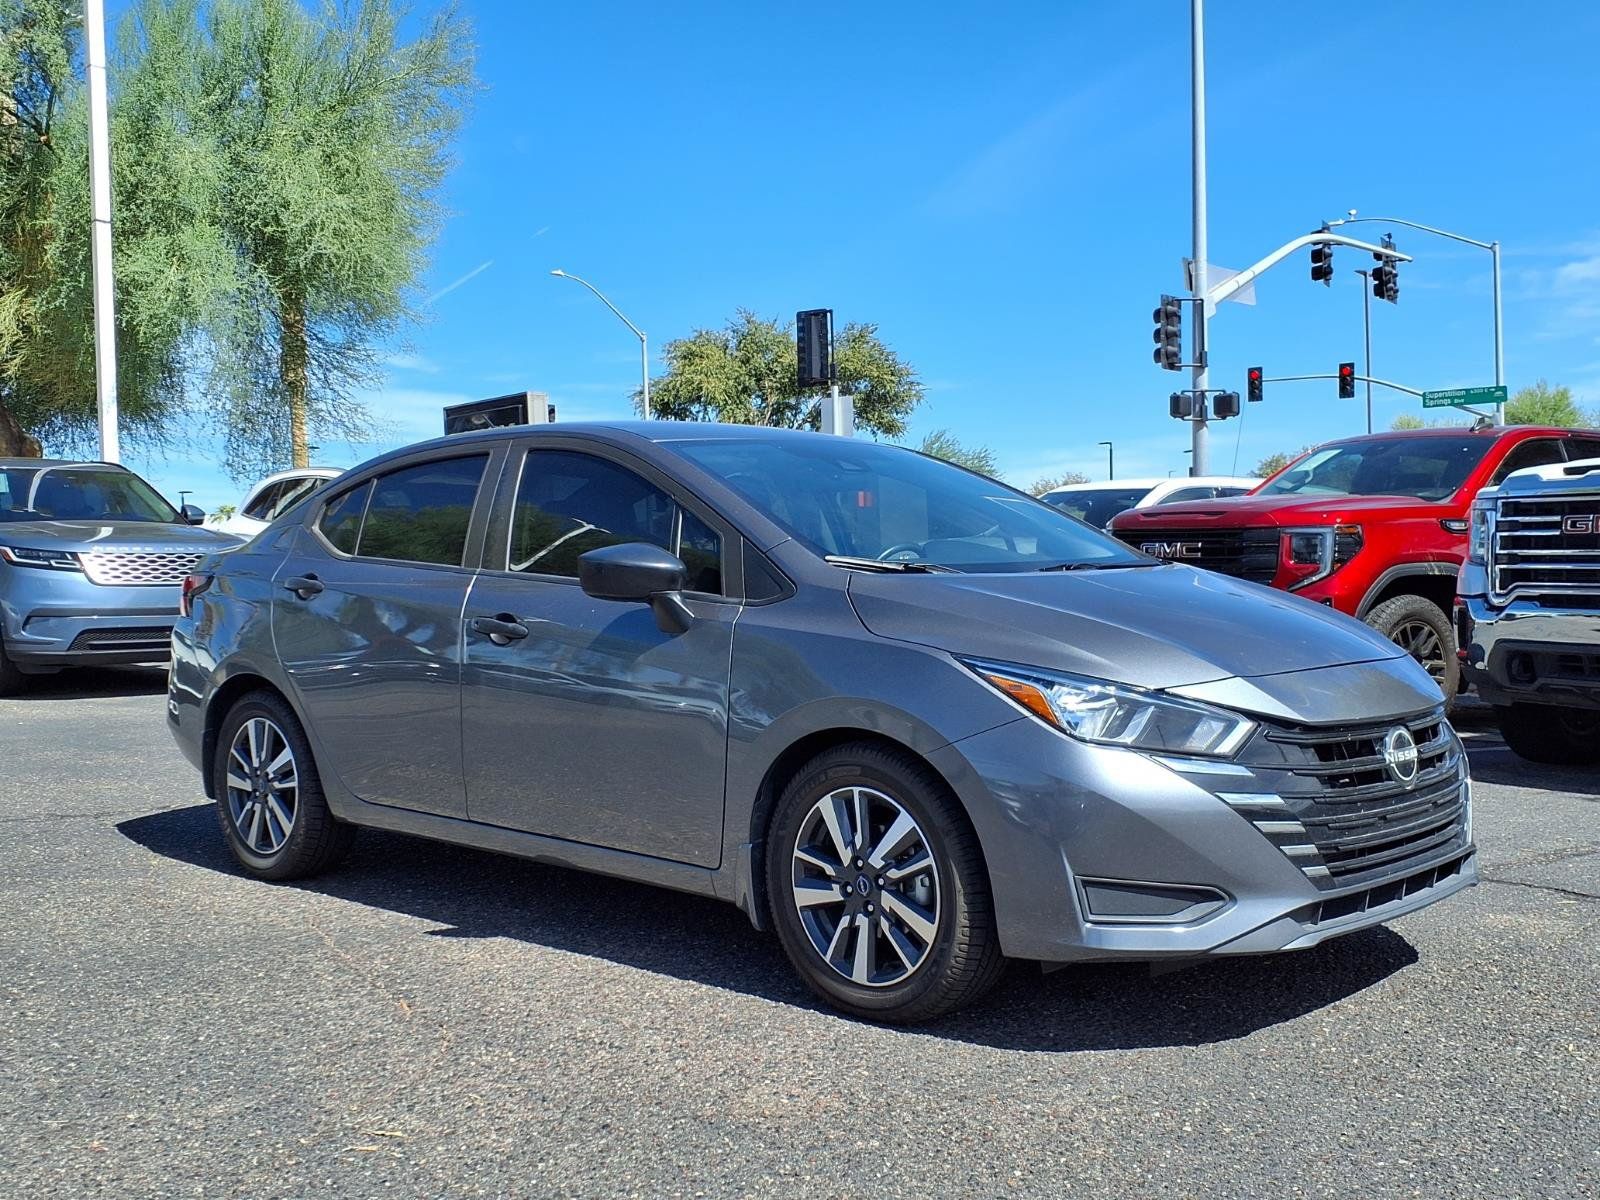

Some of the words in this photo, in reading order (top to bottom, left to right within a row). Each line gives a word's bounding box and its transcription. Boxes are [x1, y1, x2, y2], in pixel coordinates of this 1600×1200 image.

[1425, 390, 1466, 399] Superstition
[1425, 398, 1451, 406] Springs
[1562, 514, 1600, 534] G
[1140, 542, 1202, 558] GMC
[1384, 747, 1418, 764] NISSAN
